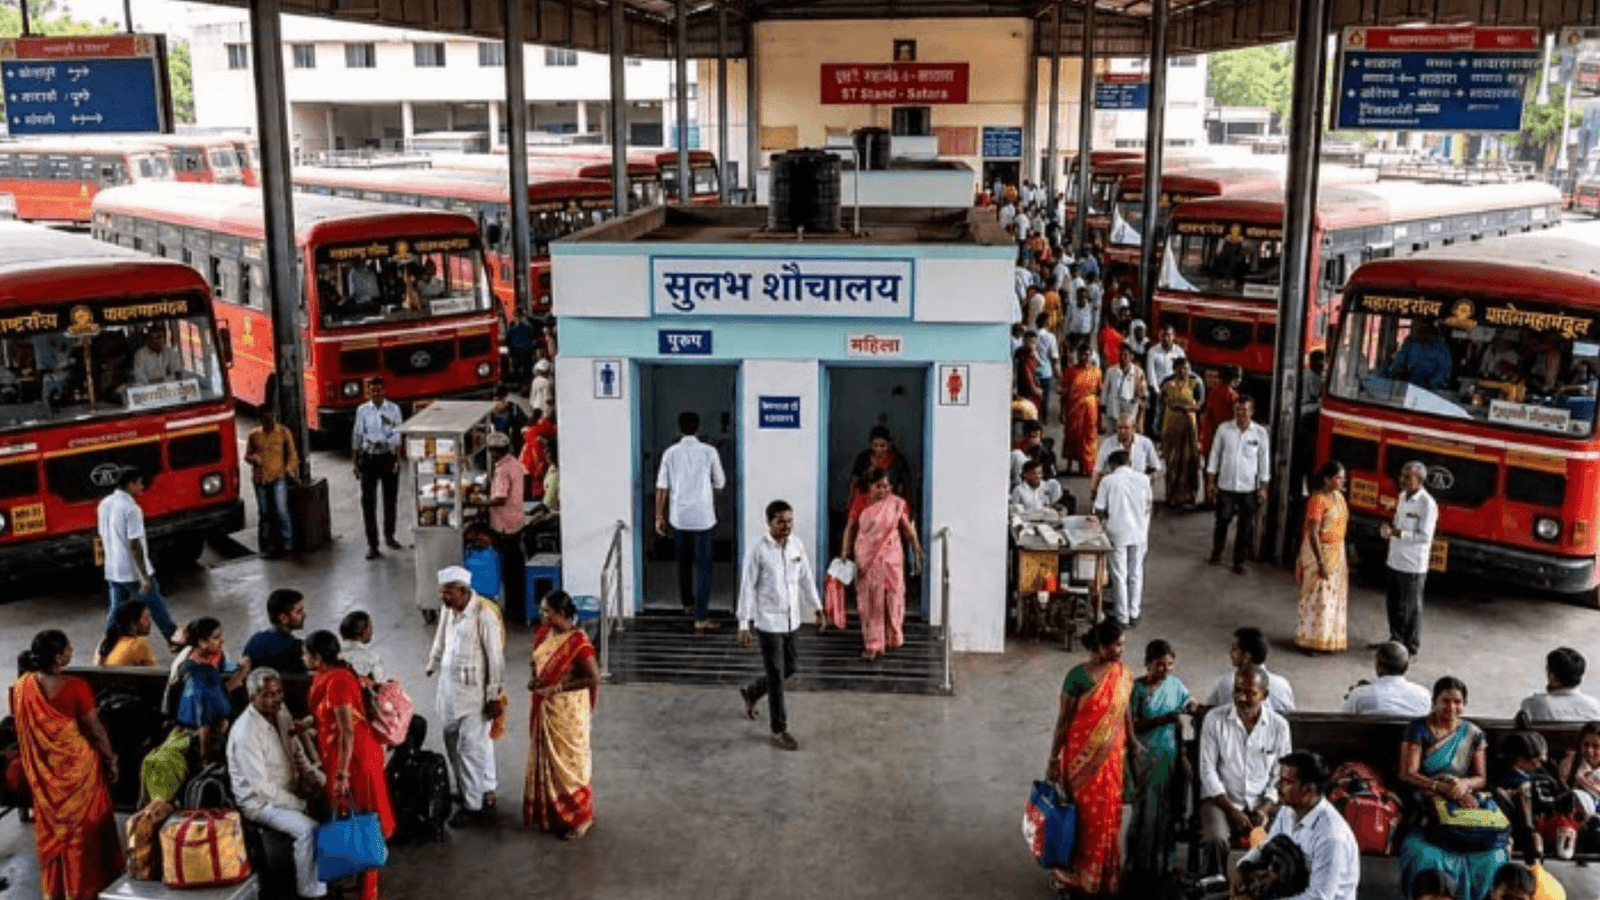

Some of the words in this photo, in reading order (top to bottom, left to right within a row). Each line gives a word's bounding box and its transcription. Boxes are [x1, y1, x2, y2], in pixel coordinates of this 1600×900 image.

[860, 87, 898, 100] Stand
[663, 271, 752, 311] सुलभ
[762, 262, 903, 302] शौचालय
[850, 334, 900, 353] महिला
